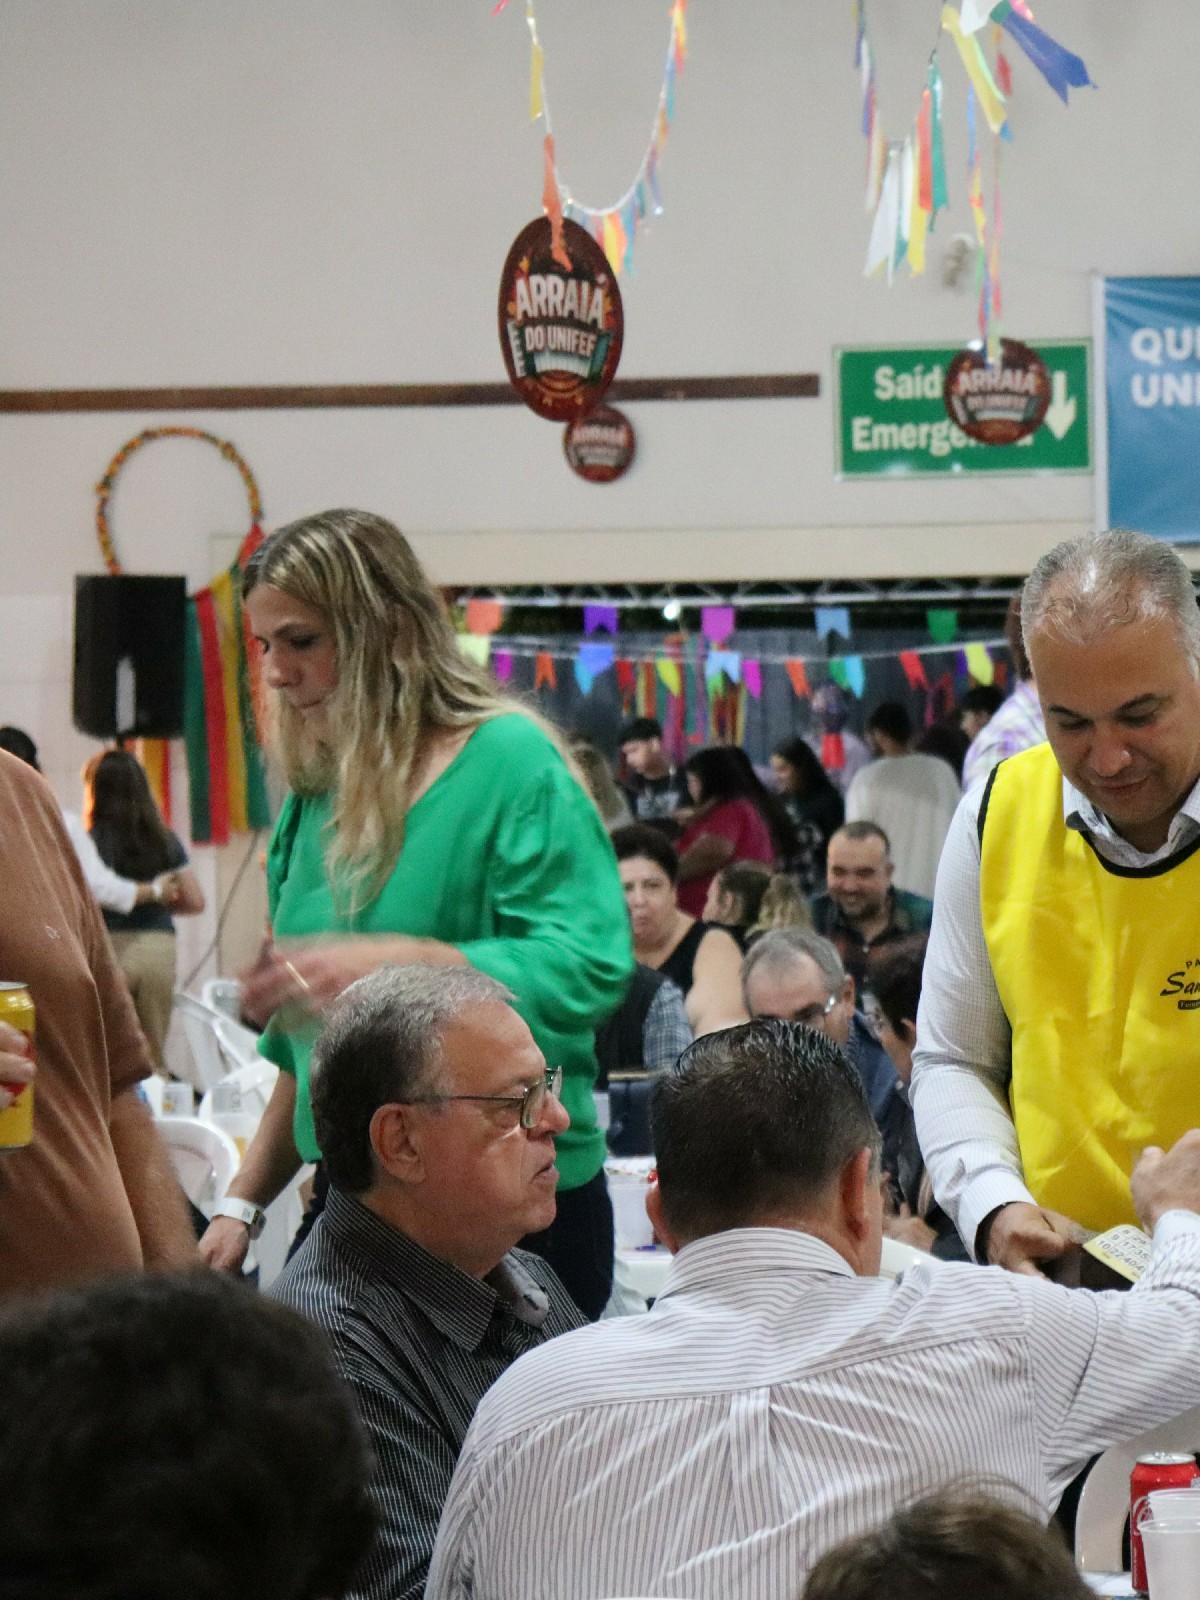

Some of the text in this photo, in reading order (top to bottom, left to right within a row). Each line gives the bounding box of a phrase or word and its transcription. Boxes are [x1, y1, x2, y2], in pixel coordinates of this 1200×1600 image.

[515, 273, 607, 329] ARRAIÁ
[524, 325, 598, 358] DO UNIFEF
[874, 363, 944, 400] Saíd
[852, 416, 1034, 456] Emerg
[1098, 1240, 1111, 1250] 10
[1110, 1248, 1125, 1258] 22
[1124, 1256, 1137, 1267] 40
[1122, 1241, 1137, 1250] 17
[1134, 1249, 1149, 1259] 35
